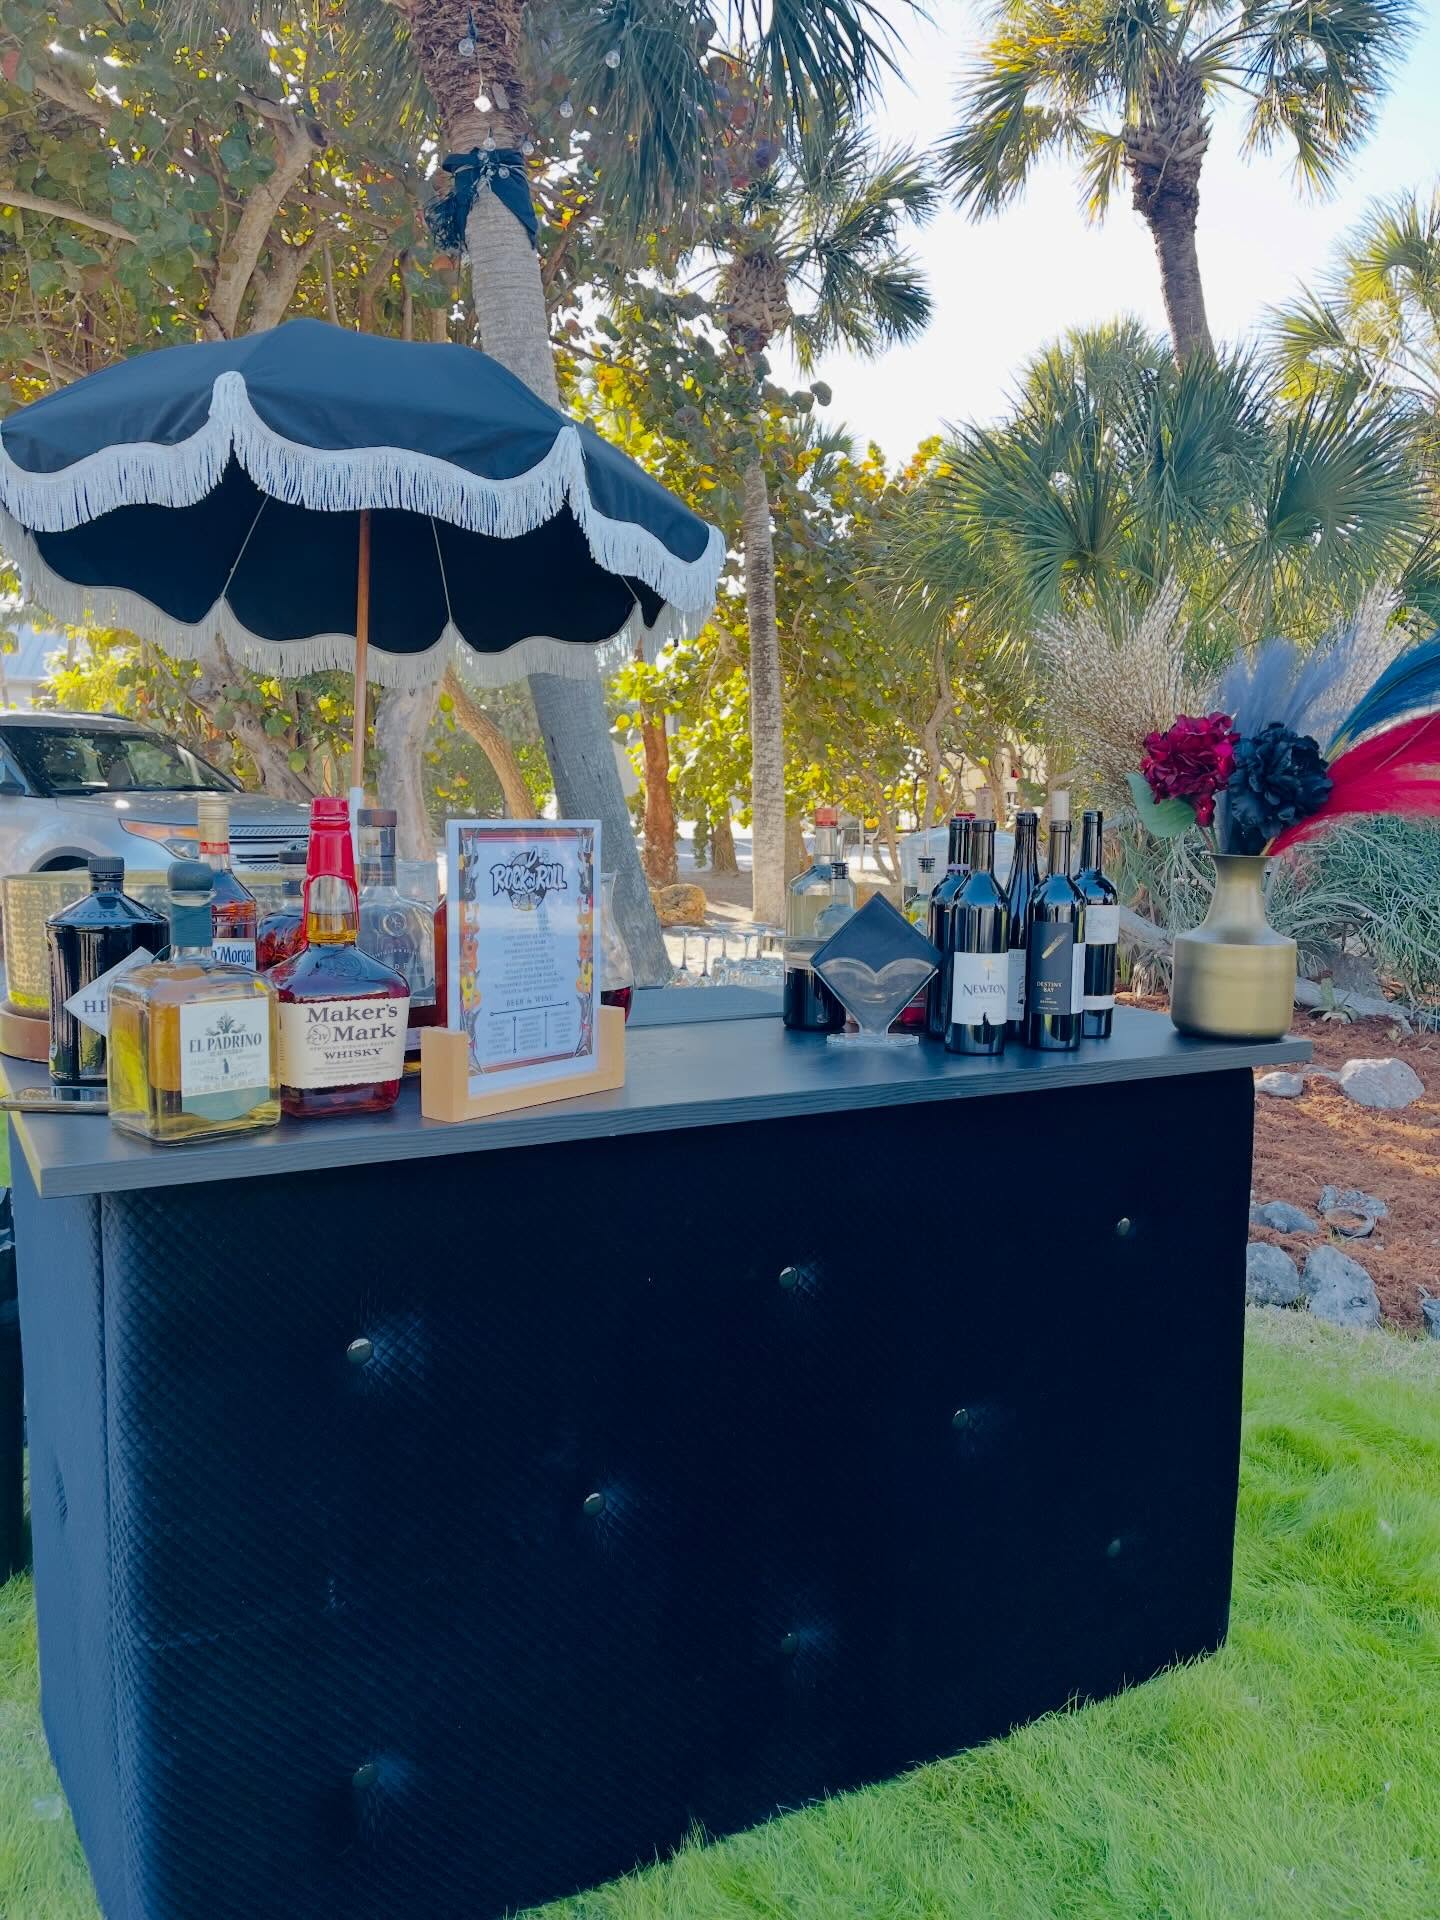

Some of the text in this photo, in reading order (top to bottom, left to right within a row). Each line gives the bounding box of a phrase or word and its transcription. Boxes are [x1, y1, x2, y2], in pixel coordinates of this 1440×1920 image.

[535, 863, 568, 891] ROLL
[963, 984, 1006, 996] NEWTON
[305, 1003, 398, 1023] Maker's
[333, 1023, 397, 1042] Mark
[190, 1039, 205, 1053] EL
[207, 1032, 262, 1051] PADRINO
[324, 1047, 383, 1060] WHISKY
